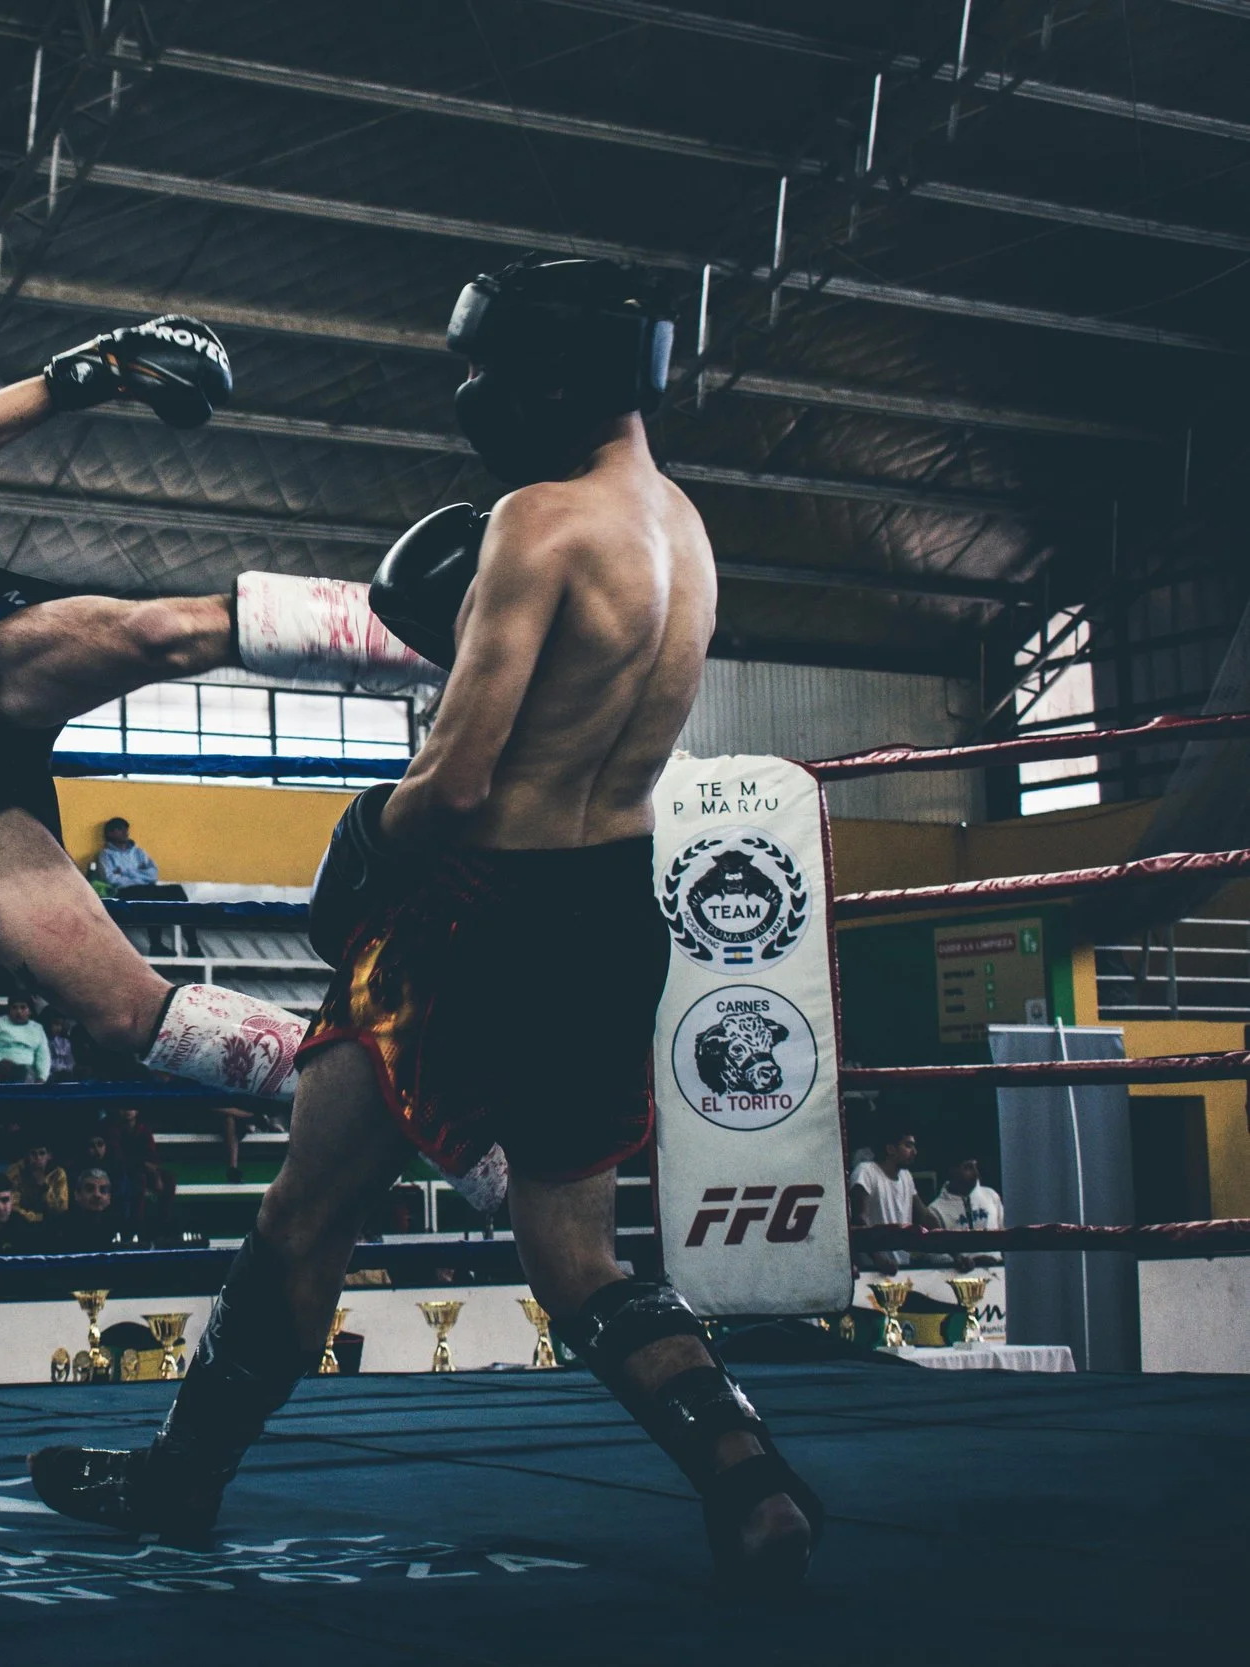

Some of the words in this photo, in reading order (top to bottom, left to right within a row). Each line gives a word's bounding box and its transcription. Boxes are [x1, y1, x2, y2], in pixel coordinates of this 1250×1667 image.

[696, 781, 756, 797] TEM
[673, 800, 731, 815] PMA
[709, 905, 761, 919] TEAM
[706, 924, 741, 941] PUMA
[744, 922, 767, 941] RYU
[716, 1000, 770, 1013] CARNES
[702, 1097, 722, 1112] EL
[727, 1094, 792, 1111] TORITO
[685, 1184, 825, 1247] FFG
